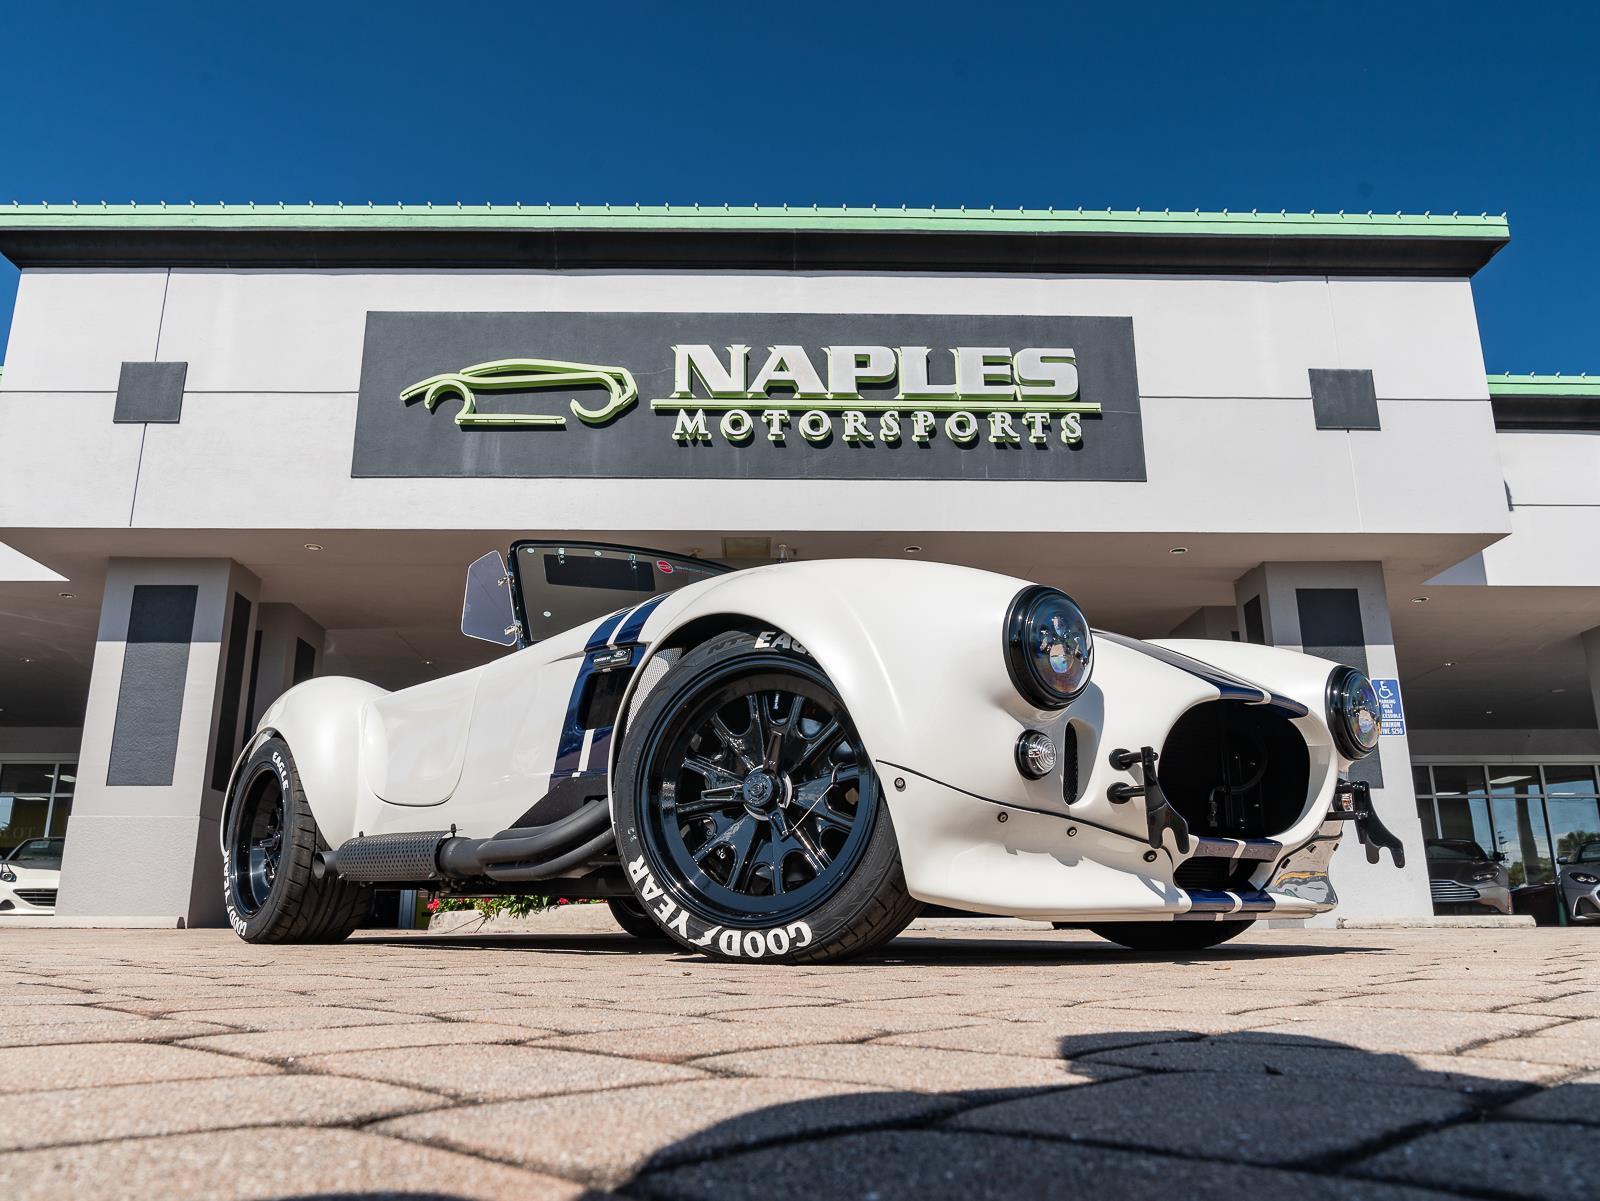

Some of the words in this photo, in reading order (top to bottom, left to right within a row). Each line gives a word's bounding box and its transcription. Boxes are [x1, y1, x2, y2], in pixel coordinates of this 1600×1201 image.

[670, 344, 1079, 401] NAPLES
[673, 408, 1083, 443] MOTORSPORTS
[272, 751, 289, 791] EAGLE
